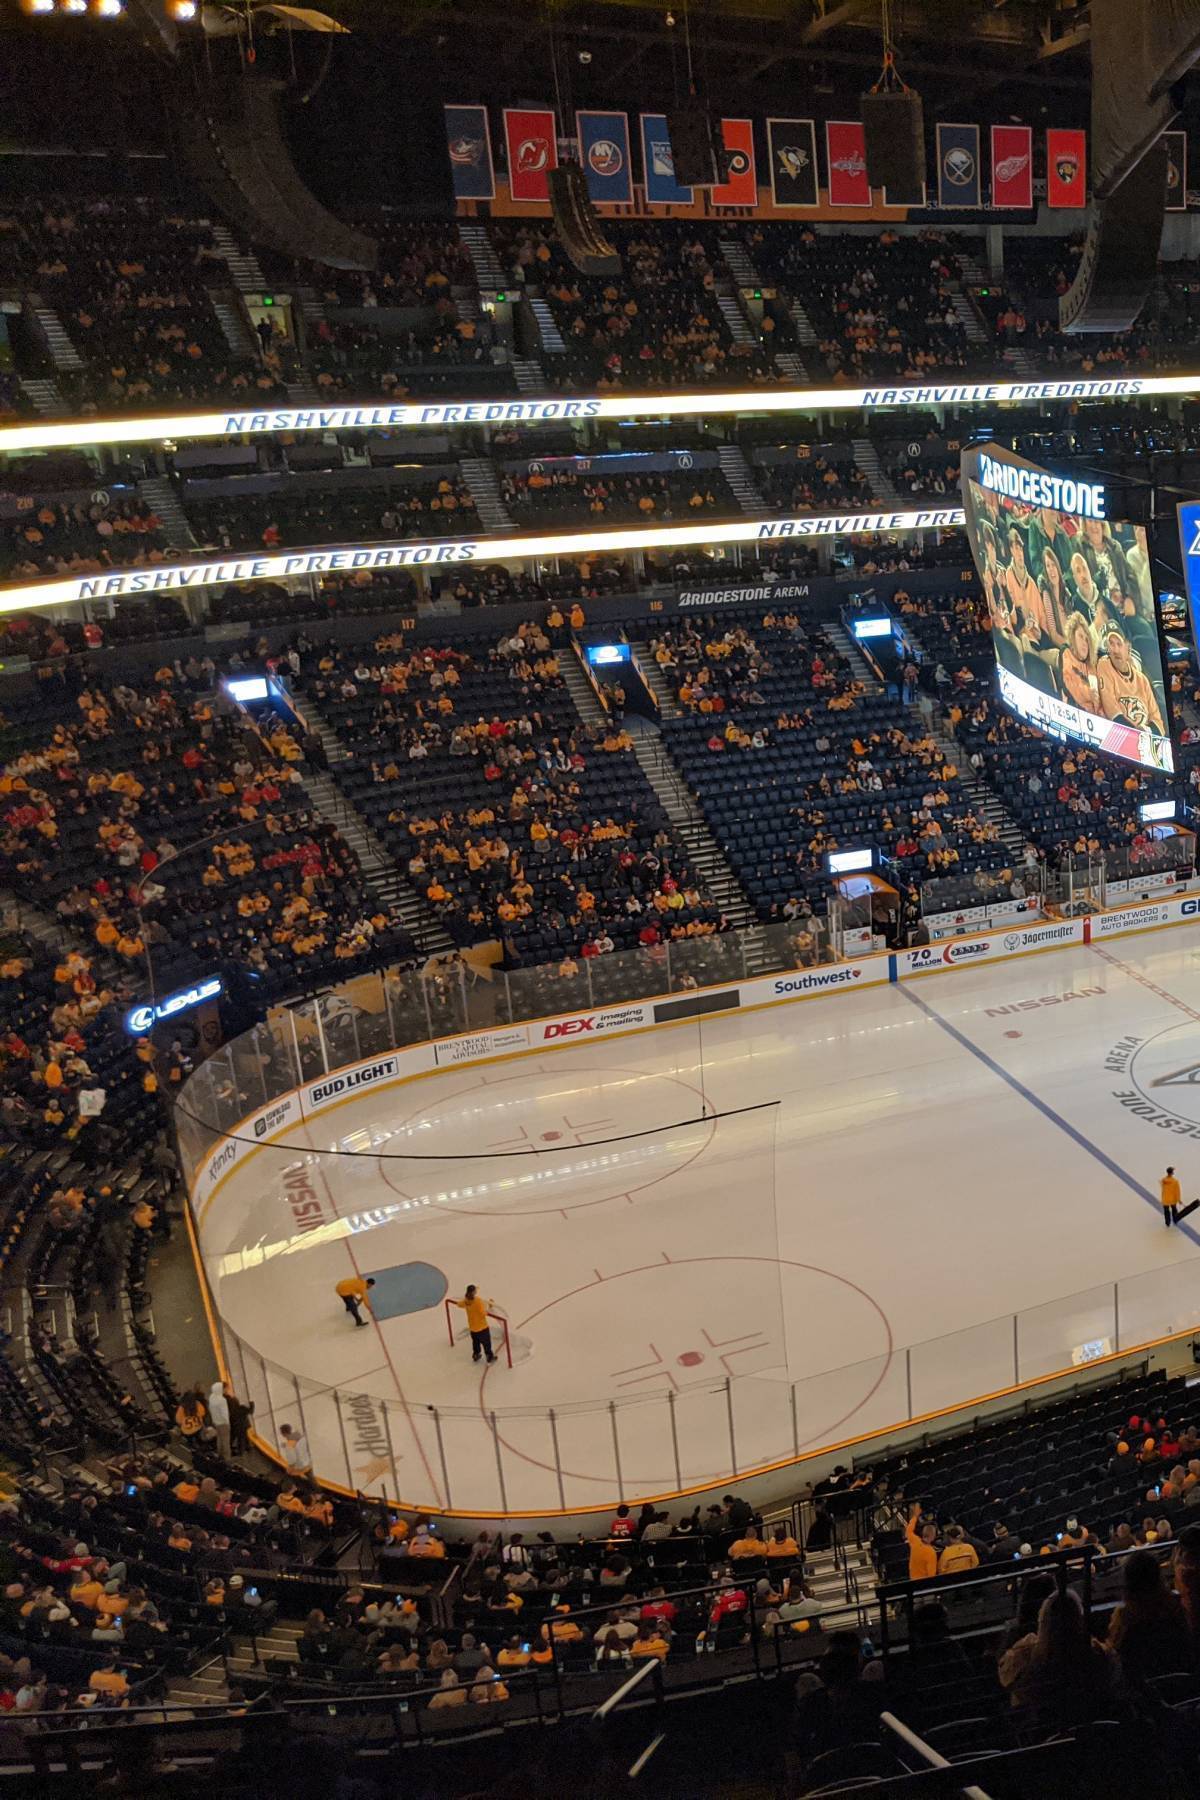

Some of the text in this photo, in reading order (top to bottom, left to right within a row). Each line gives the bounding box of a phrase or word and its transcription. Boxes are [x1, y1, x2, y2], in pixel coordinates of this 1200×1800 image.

[863, 380, 1143, 405] NASHVILLE PREDATORS
[225, 400, 602, 433] NASHVILLE PREDATORS
[979, 452, 1106, 519] BRIDGESTONE
[758, 513, 905, 538] NASHVILLE
[79, 544, 478, 599] NASHVILLE PREDATORS
[678, 585, 810, 608] BRIDGESTONE ARENA
[1100, 906, 1159, 925] BRENTWOOD
[1100, 914, 1159, 932] AUTO BROKERS
[911, 958, 942, 969] MILLION
[774, 967, 852, 994] Southwest
[156, 979, 222, 1018] LEXUS
[984, 985, 1107, 1018] NISSAN
[600, 1006, 643, 1021] imaging
[543, 1016, 597, 1039] DEX
[1104, 1034, 1144, 1074] ARENA
[312, 1061, 394, 1102] BUD LIGHT
[208, 1141, 238, 1181] xfinity
